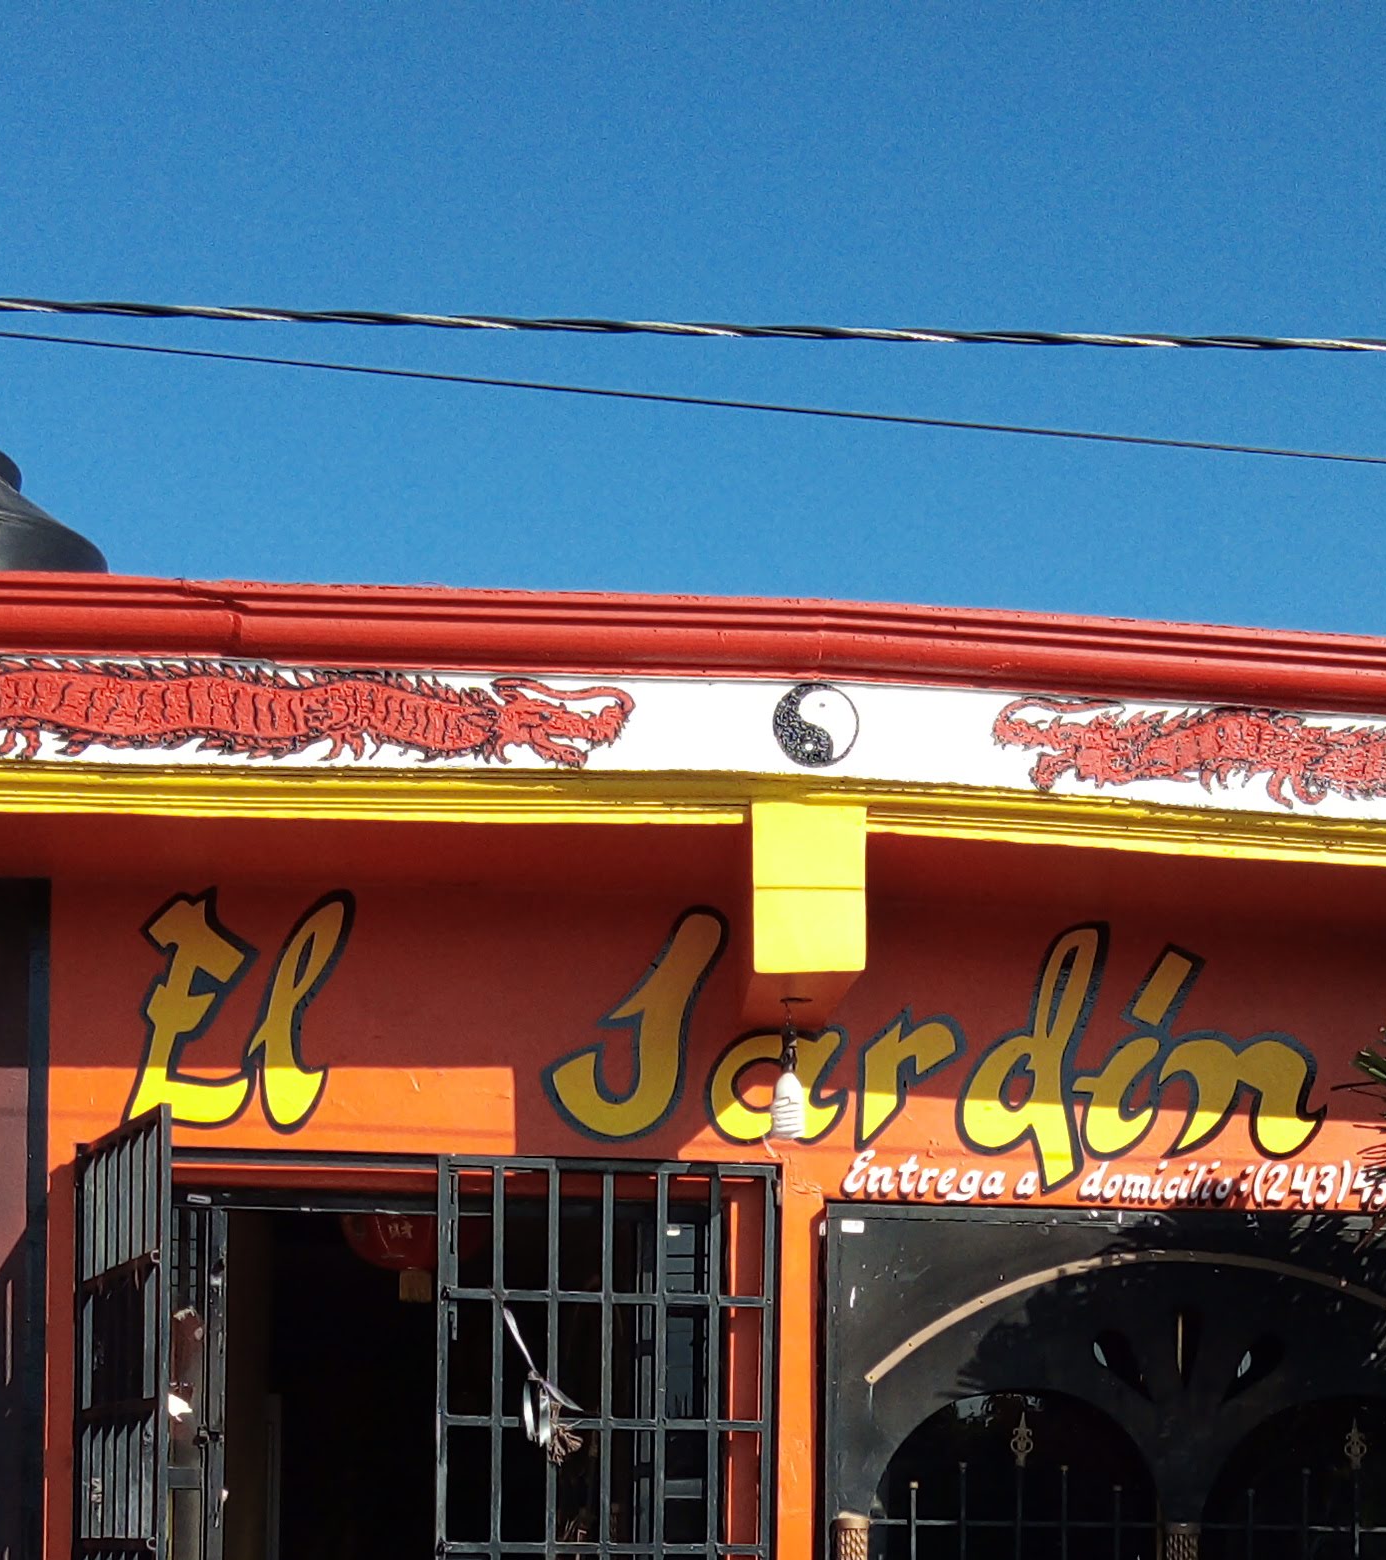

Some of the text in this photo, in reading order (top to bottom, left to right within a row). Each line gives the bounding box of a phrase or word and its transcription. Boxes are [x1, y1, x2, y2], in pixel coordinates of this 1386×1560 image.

[129, 886, 356, 1134] El
[842, 1147, 1006, 1203] Entrega
[1015, 1168, 1041, 1195] a
[1078, 1158, 1236, 1201] domicilio
